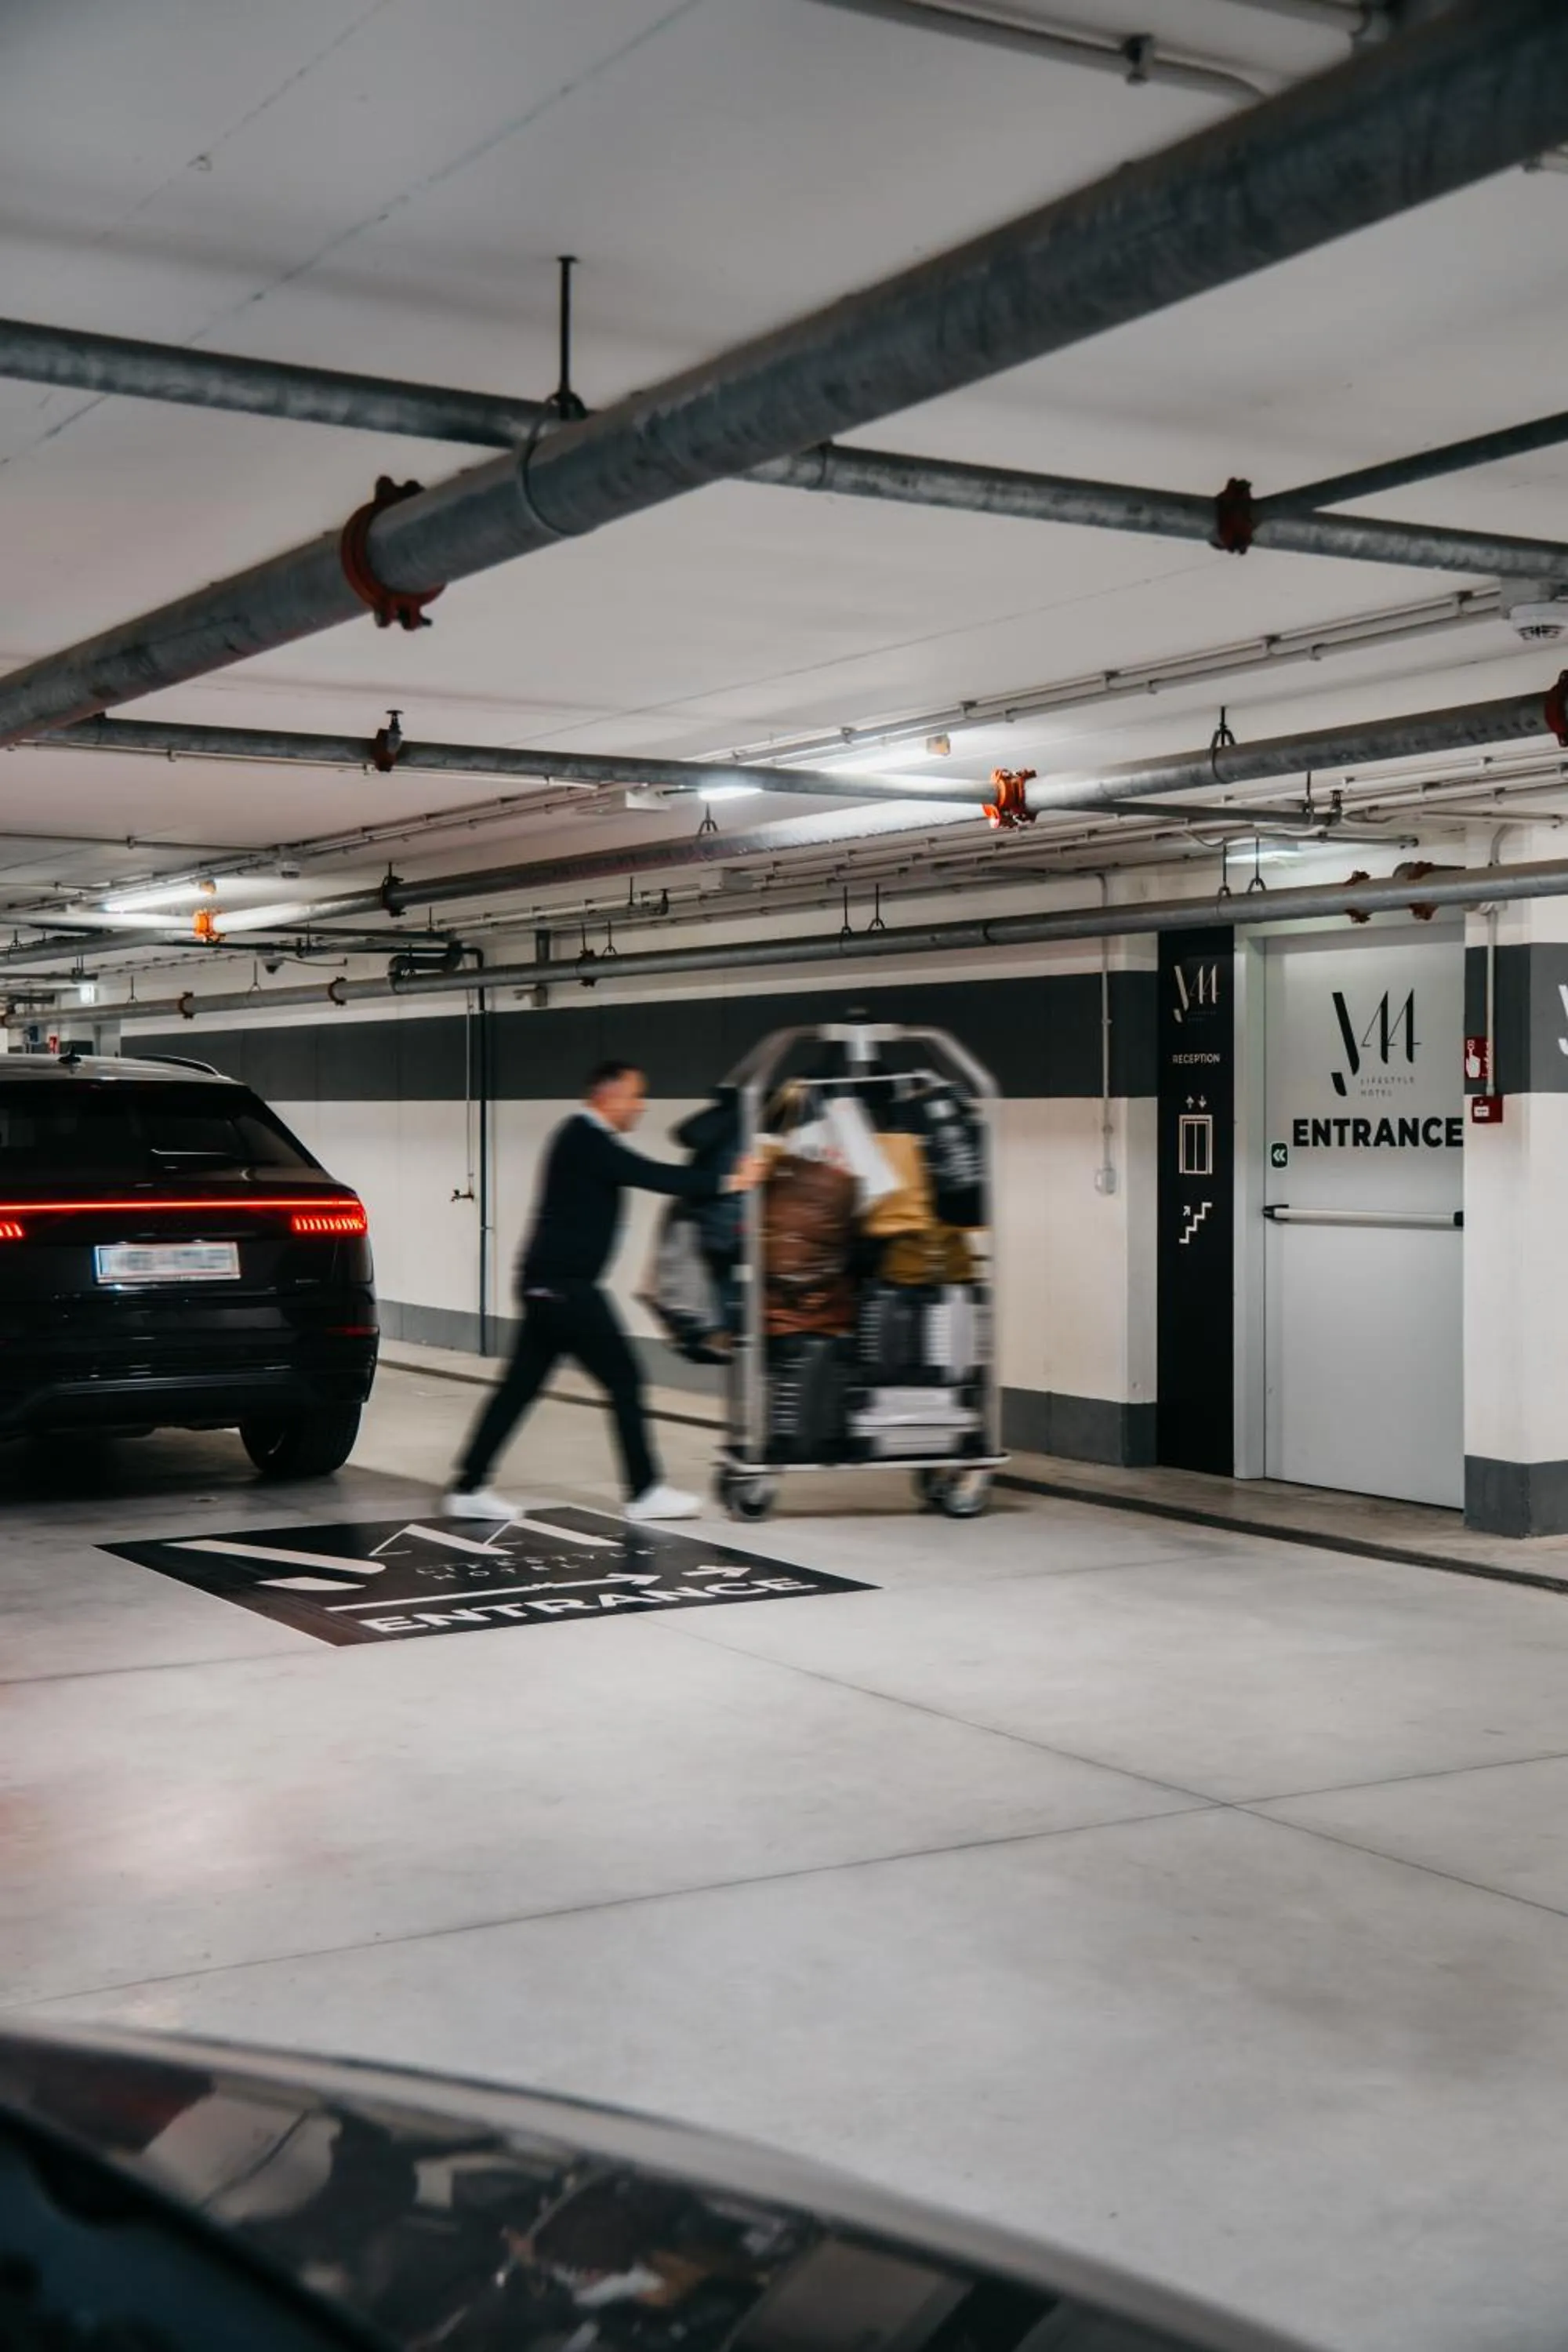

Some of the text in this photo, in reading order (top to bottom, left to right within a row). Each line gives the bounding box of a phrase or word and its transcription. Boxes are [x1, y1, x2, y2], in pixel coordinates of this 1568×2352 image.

[1172, 1053, 1221, 1064] RECEPTION
[1360, 1088, 1392, 1098] HOTEL
[1292, 1117, 1464, 1148] ENTRANCE
[357, 1578, 820, 1633] ENTRANCE
